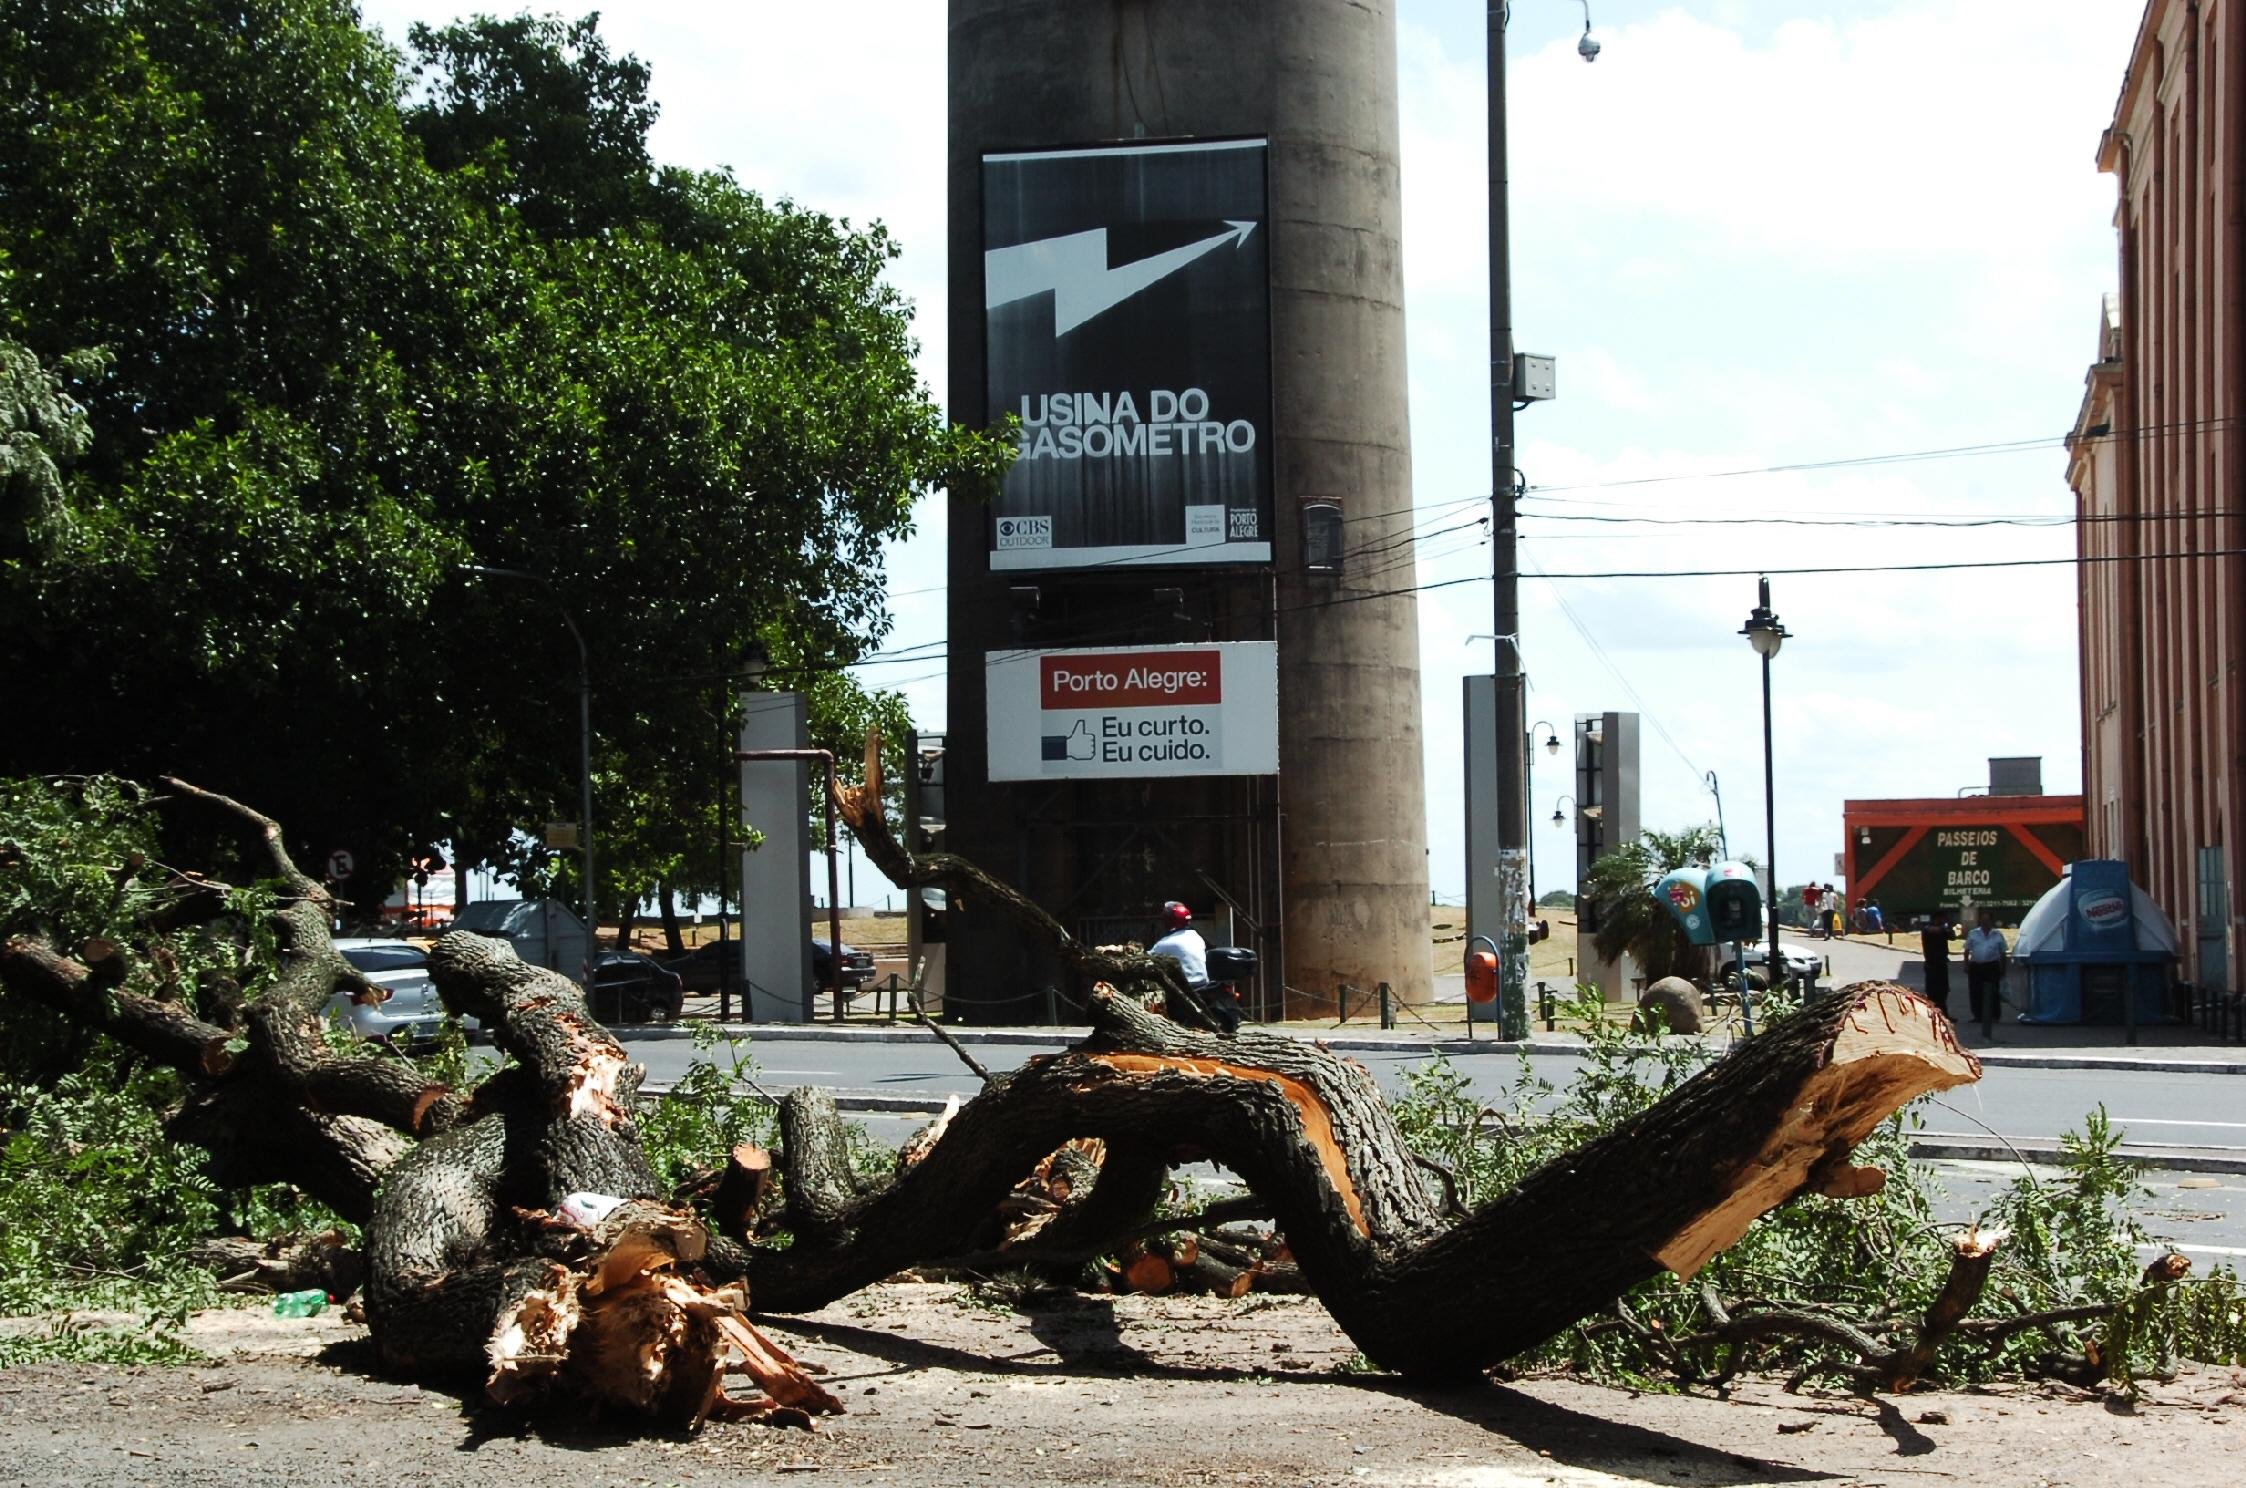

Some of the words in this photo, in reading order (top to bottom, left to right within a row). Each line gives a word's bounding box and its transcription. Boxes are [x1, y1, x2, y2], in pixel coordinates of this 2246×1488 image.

[1021, 392, 1141, 427] USINA
[1150, 388, 1209, 423] DO
[1016, 520, 1049, 535] CBS
[1000, 536, 1049, 547] OUTDOOR
[1053, 670, 1118, 692] Porto
[1123, 668, 1207, 693] Alegre:
[1102, 716, 1132, 738] Eu
[1138, 715, 1210, 736] curto.
[1102, 741, 1132, 762] Eu
[1138, 739, 1210, 761] cuido.
[1937, 831, 1998, 847] PASSEIOS
[1961, 851, 1978, 866] DE
[1947, 870, 1990, 886] BARCO
